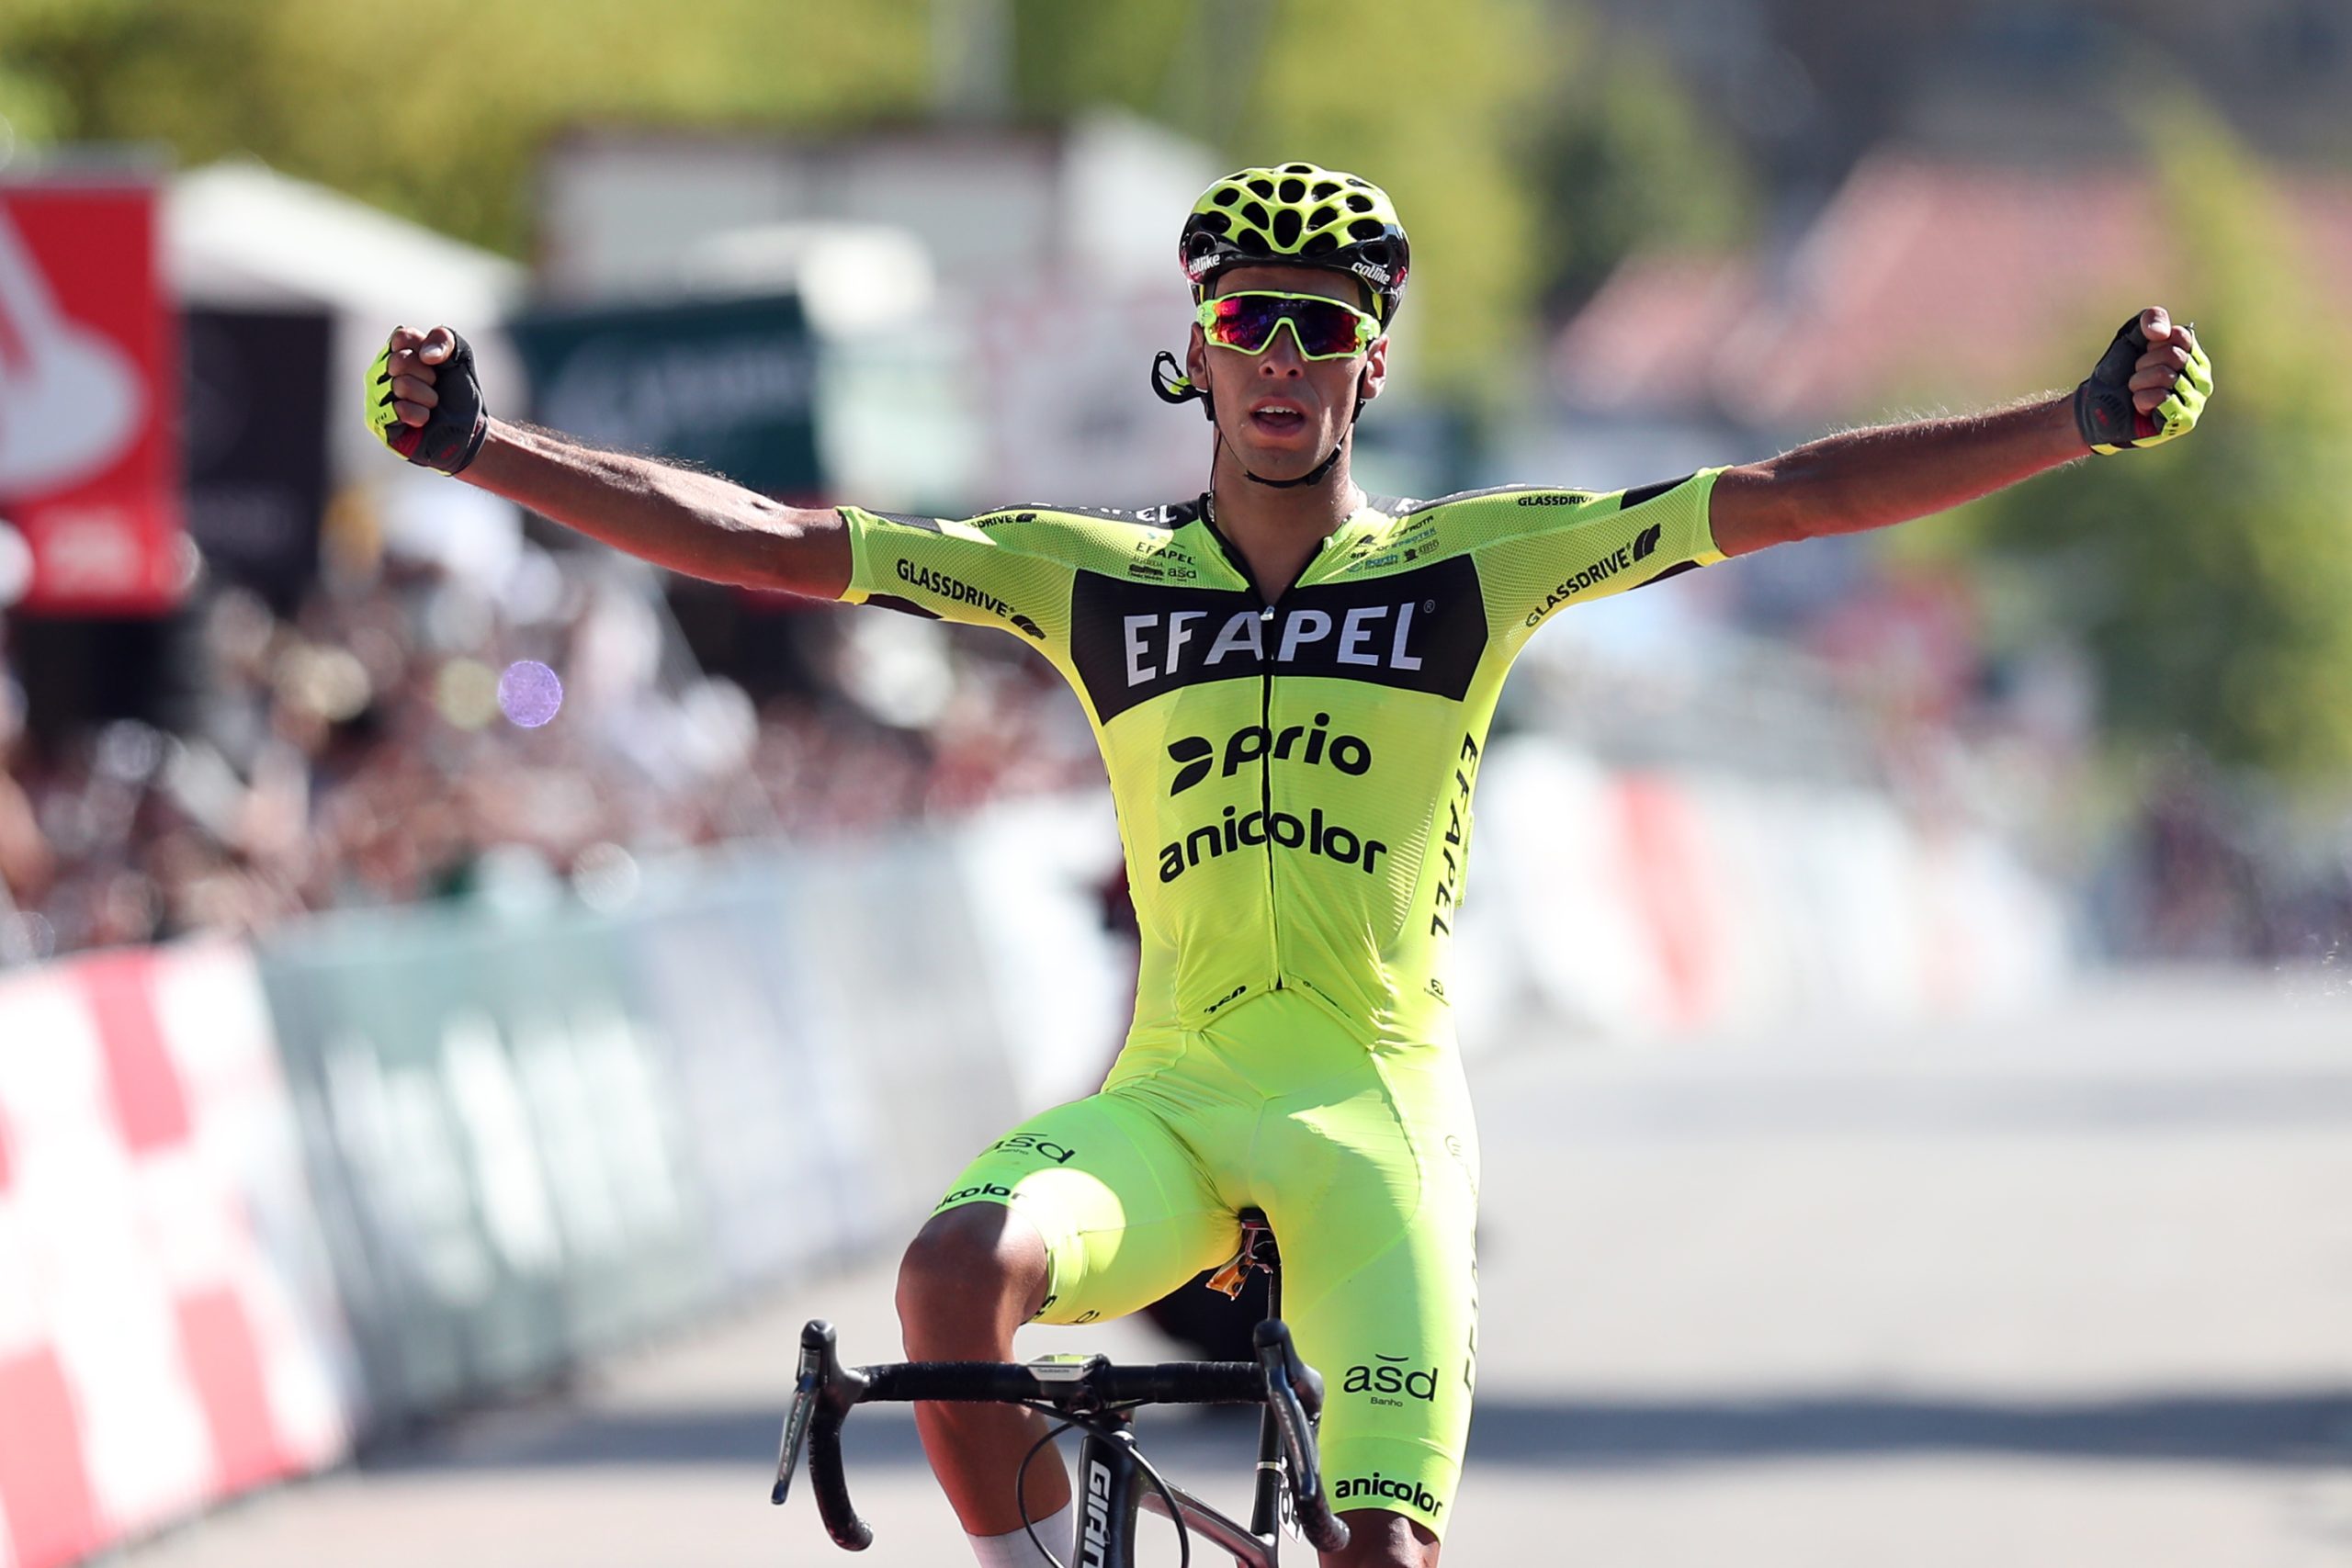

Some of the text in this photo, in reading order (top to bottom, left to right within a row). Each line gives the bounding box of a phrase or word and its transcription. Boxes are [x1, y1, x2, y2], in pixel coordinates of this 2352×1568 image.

[1351, 261, 1390, 286] catlike
[897, 558, 1007, 618] GLASSDRIVE
[1525, 550, 1631, 628] GLASSDRIVE
[1124, 602, 1423, 687] EFAPEL
[1222, 713, 1372, 777] prio
[1159, 806, 1387, 883] anicolor
[1430, 732, 1477, 937] EFAPEL
[1370, 1396, 1403, 1407] Banho
[1335, 1472, 1442, 1517] anicolor
